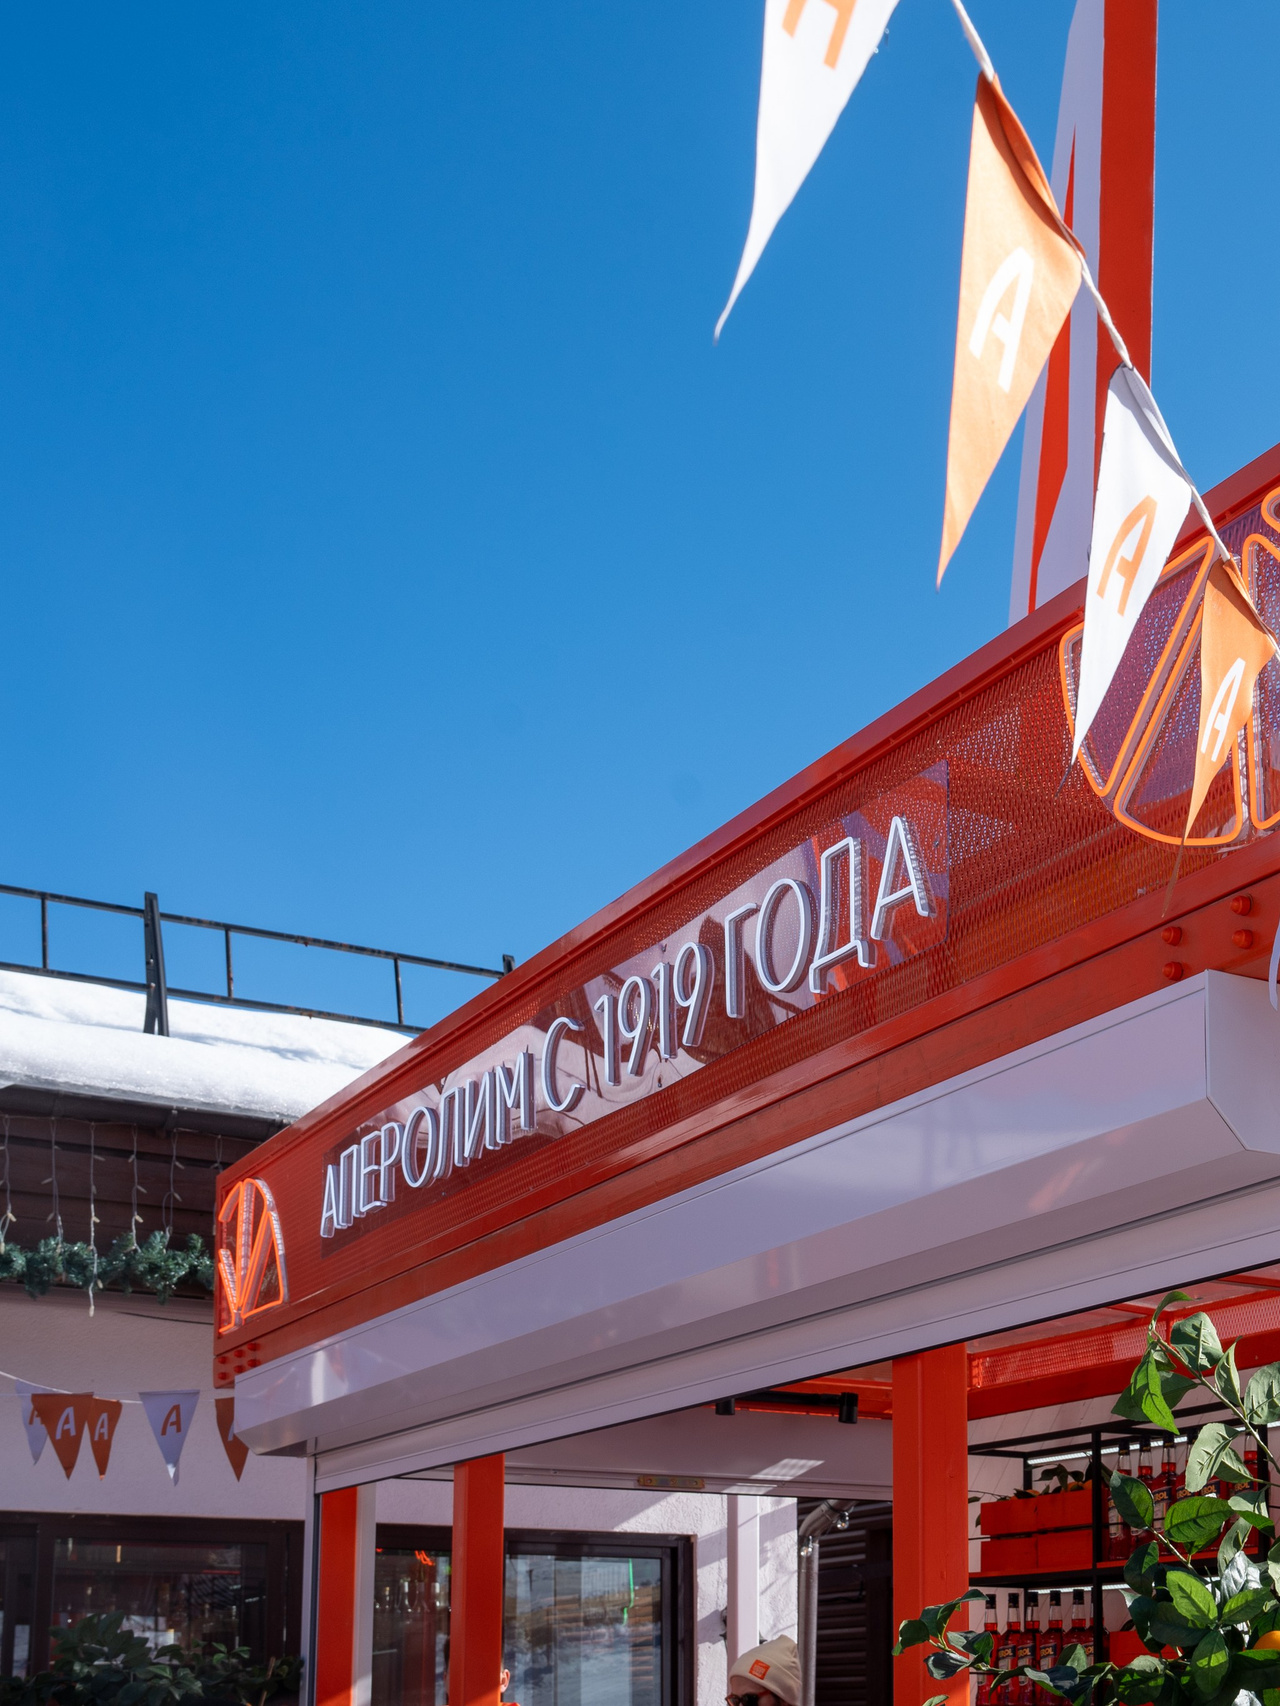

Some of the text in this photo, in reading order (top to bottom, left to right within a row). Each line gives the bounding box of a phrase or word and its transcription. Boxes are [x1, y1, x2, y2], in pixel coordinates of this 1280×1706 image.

[969, 246, 1035, 394] A
[1096, 495, 1158, 617] A
[1200, 657, 1246, 763] A
[320, 814, 936, 1238] АПЕРОЛИМ С 1919 ГОДА
[55, 1406, 77, 1440] A
[94, 1412, 109, 1441] A
[160, 1403, 182, 1437] A
